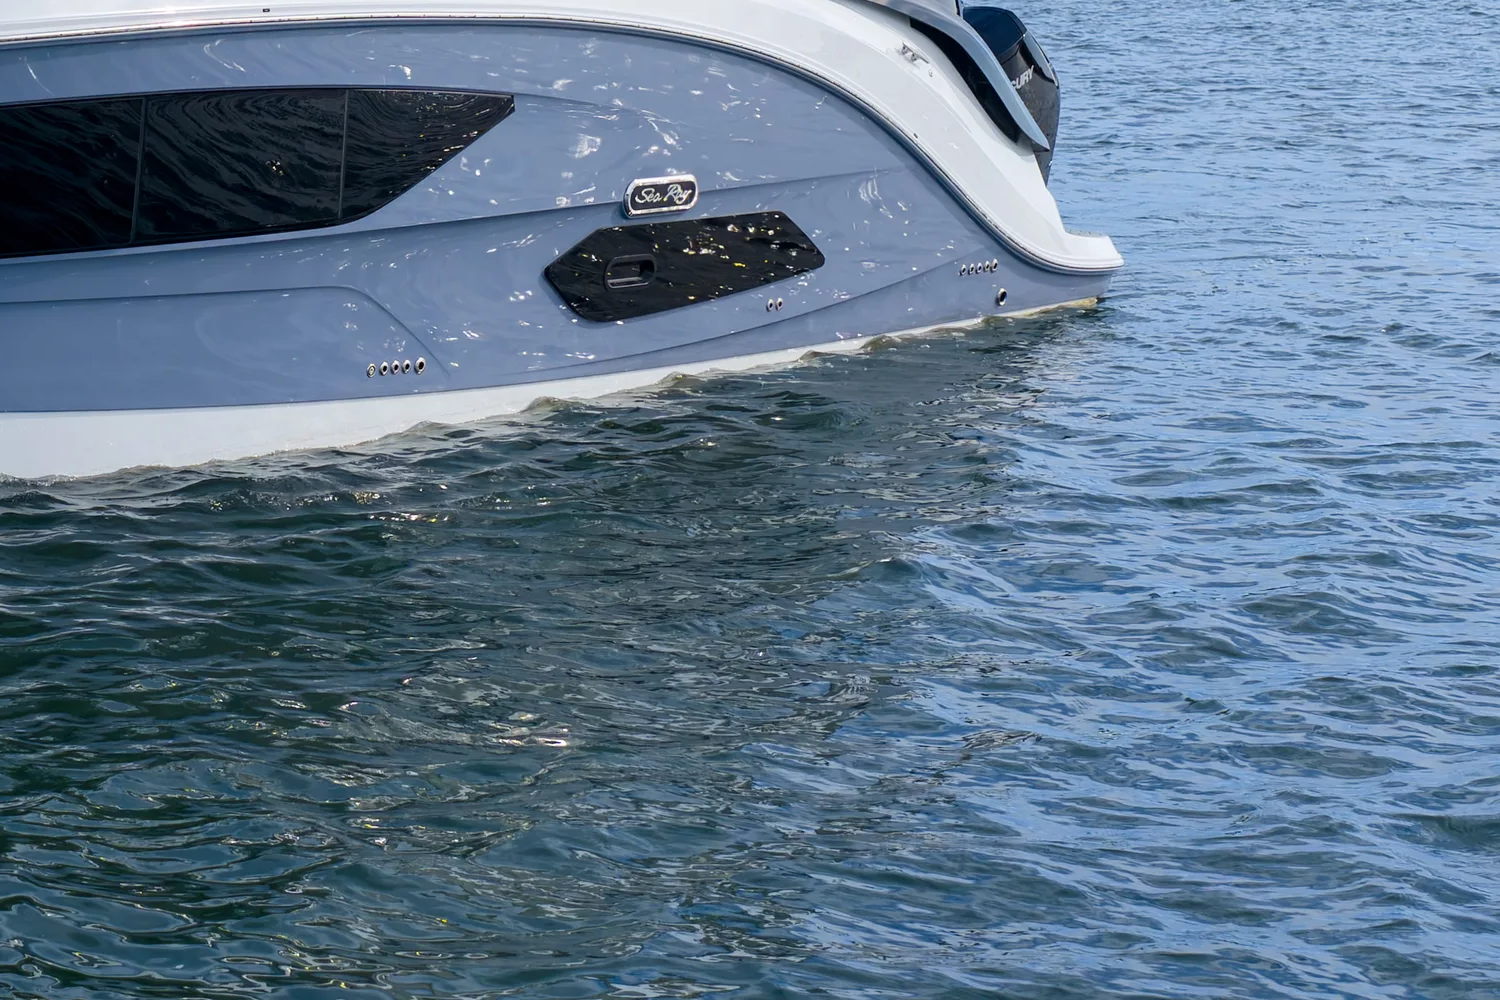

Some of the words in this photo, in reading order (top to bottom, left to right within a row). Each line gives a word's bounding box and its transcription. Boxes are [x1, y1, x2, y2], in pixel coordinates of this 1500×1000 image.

[1011, 64, 1035, 90] CURY
[635, 188, 663, 203] Sea
[663, 184, 692, 204] Ray
